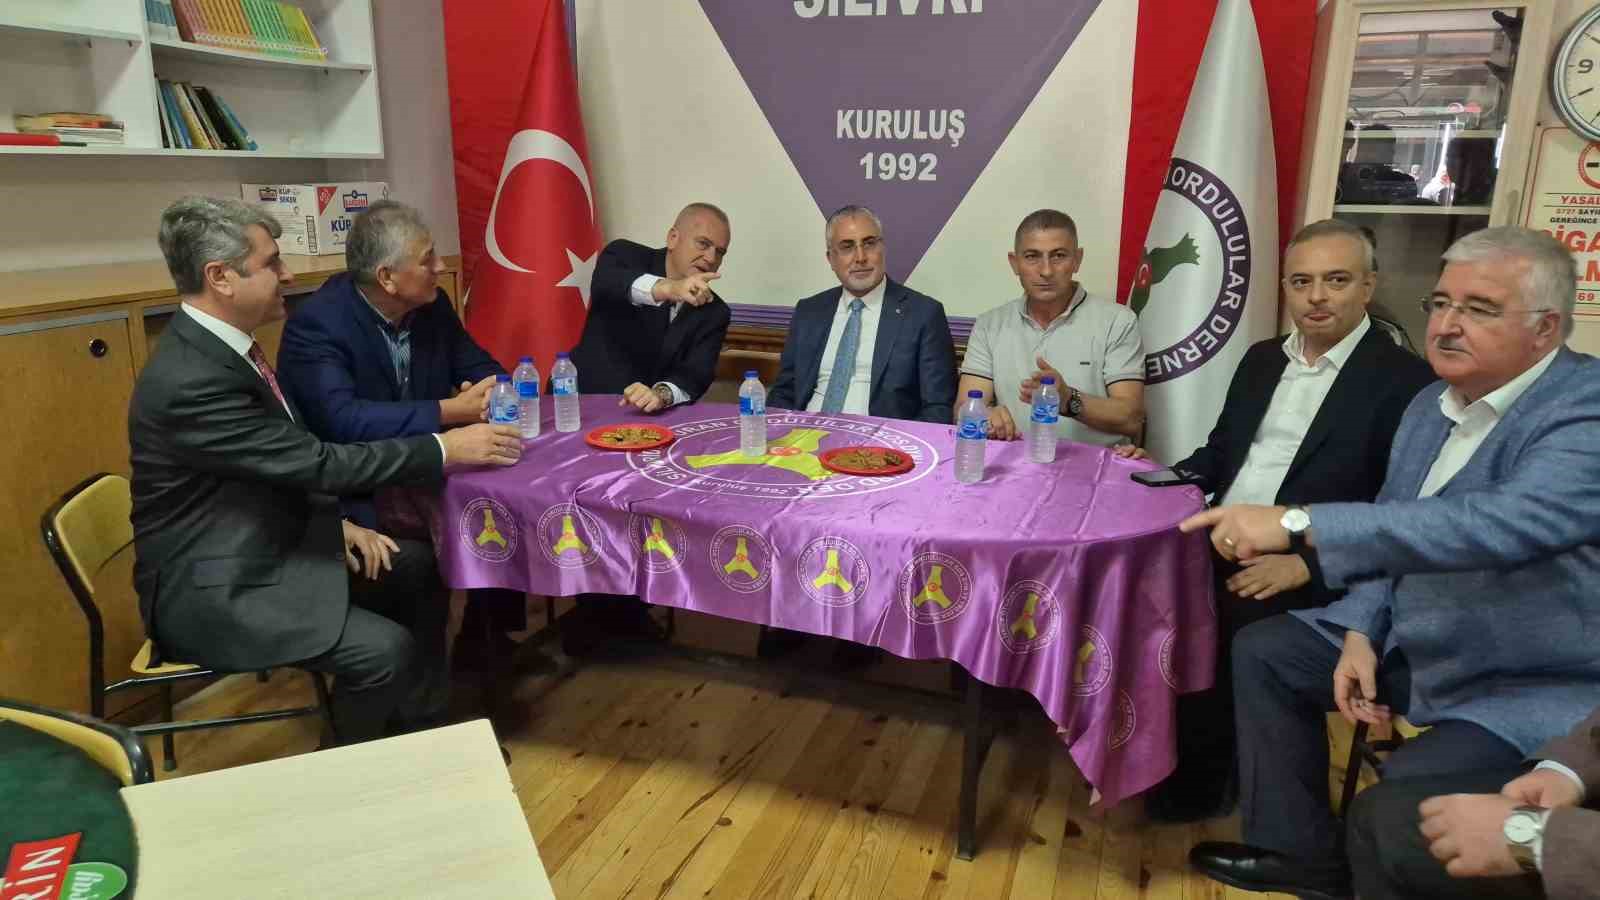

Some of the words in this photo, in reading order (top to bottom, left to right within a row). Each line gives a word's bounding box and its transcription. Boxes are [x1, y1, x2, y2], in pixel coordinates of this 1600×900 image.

[1577, 59, 1594, 74] 9
[836, 109, 966, 147] KURULUŞ
[859, 152, 938, 181] 1992
[1171, 166, 1247, 310] ORDULULAR
[1146, 314, 1232, 377] DERNE
